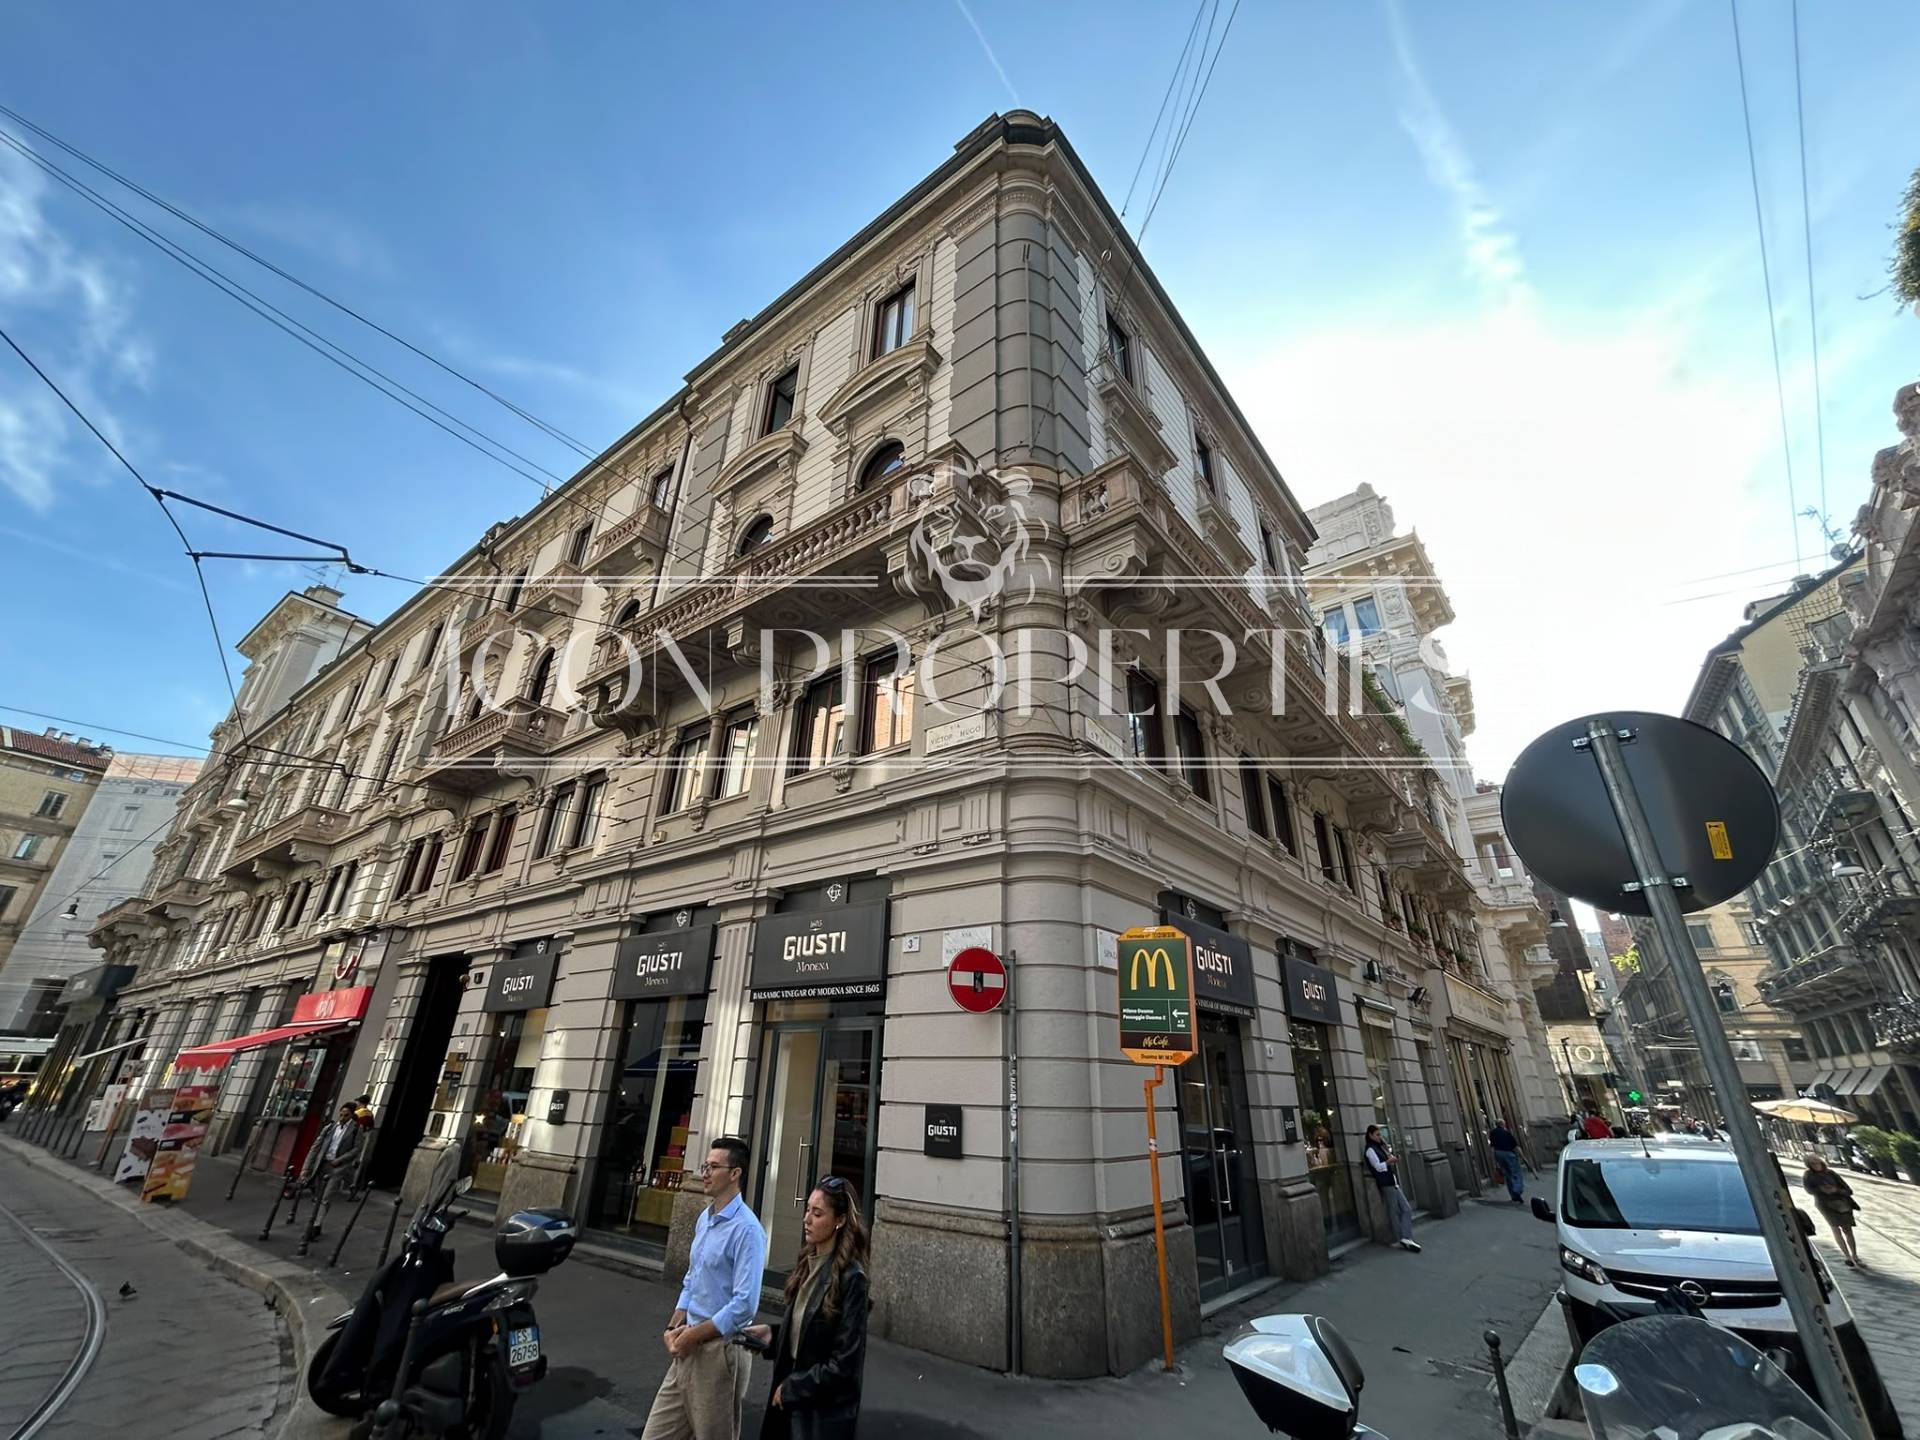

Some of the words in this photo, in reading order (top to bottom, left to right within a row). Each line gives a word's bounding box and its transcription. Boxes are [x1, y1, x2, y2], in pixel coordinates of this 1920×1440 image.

[959, 725, 982, 737] HUGO
[783, 931, 847, 961] GIUSTI
[907, 939, 913, 949] 3
[636, 951, 683, 977] GIUSTI
[1195, 945, 1233, 976] GIUSTI
[502, 975, 534, 995] GIUSTI
[753, 989, 781, 1000] BALSAMIC
[781, 988, 808, 998] VINEGAR
[808, 987, 816, 997] OF
[816, 986, 844, 996] MODENA
[845, 985, 864, 995] SINCE
[865, 984, 880, 993] 1605
[1302, 979, 1327, 1001] GIUSTI
[927, 1124, 957, 1137] GIUSTI
[511, 1343, 538, 1364] 26758
